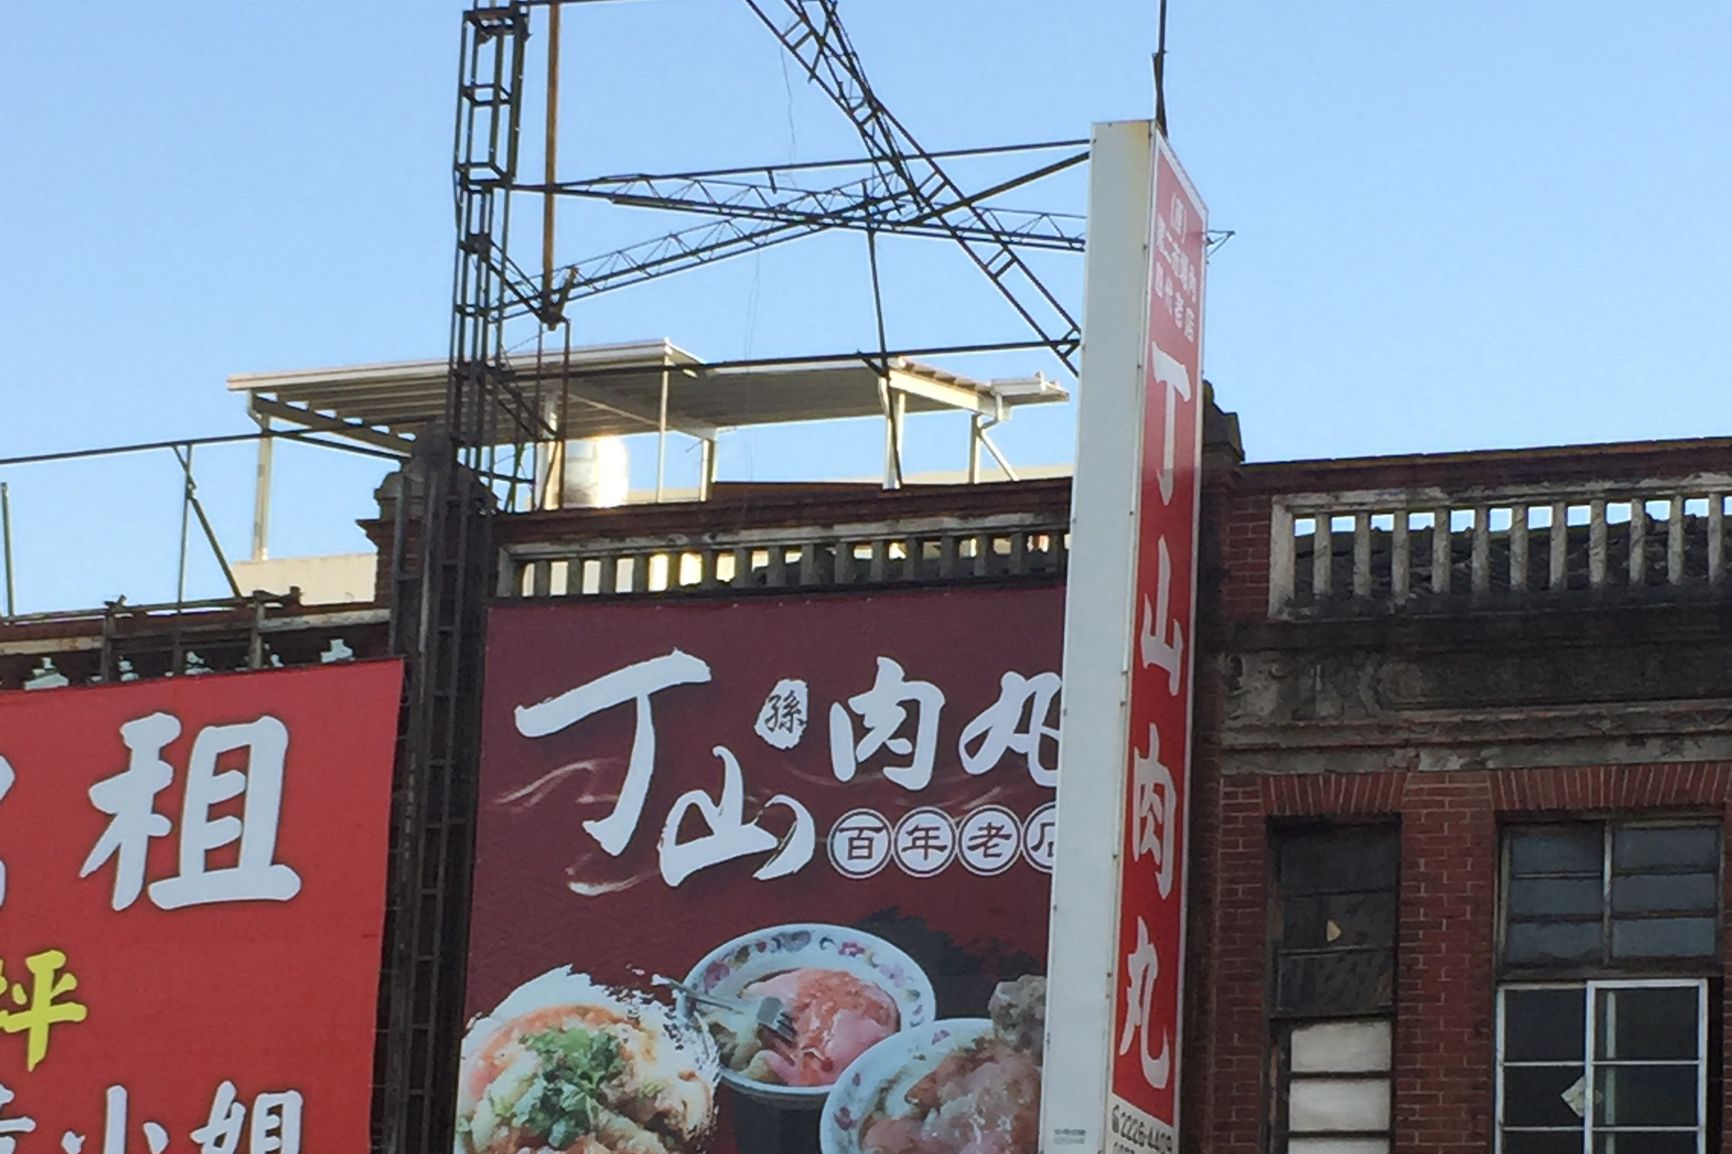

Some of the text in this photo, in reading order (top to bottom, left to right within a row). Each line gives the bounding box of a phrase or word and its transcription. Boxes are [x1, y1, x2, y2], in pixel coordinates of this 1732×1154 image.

[0, 711, 301, 911] 租
[1119, 341, 1191, 1089] 丁山肉丸
